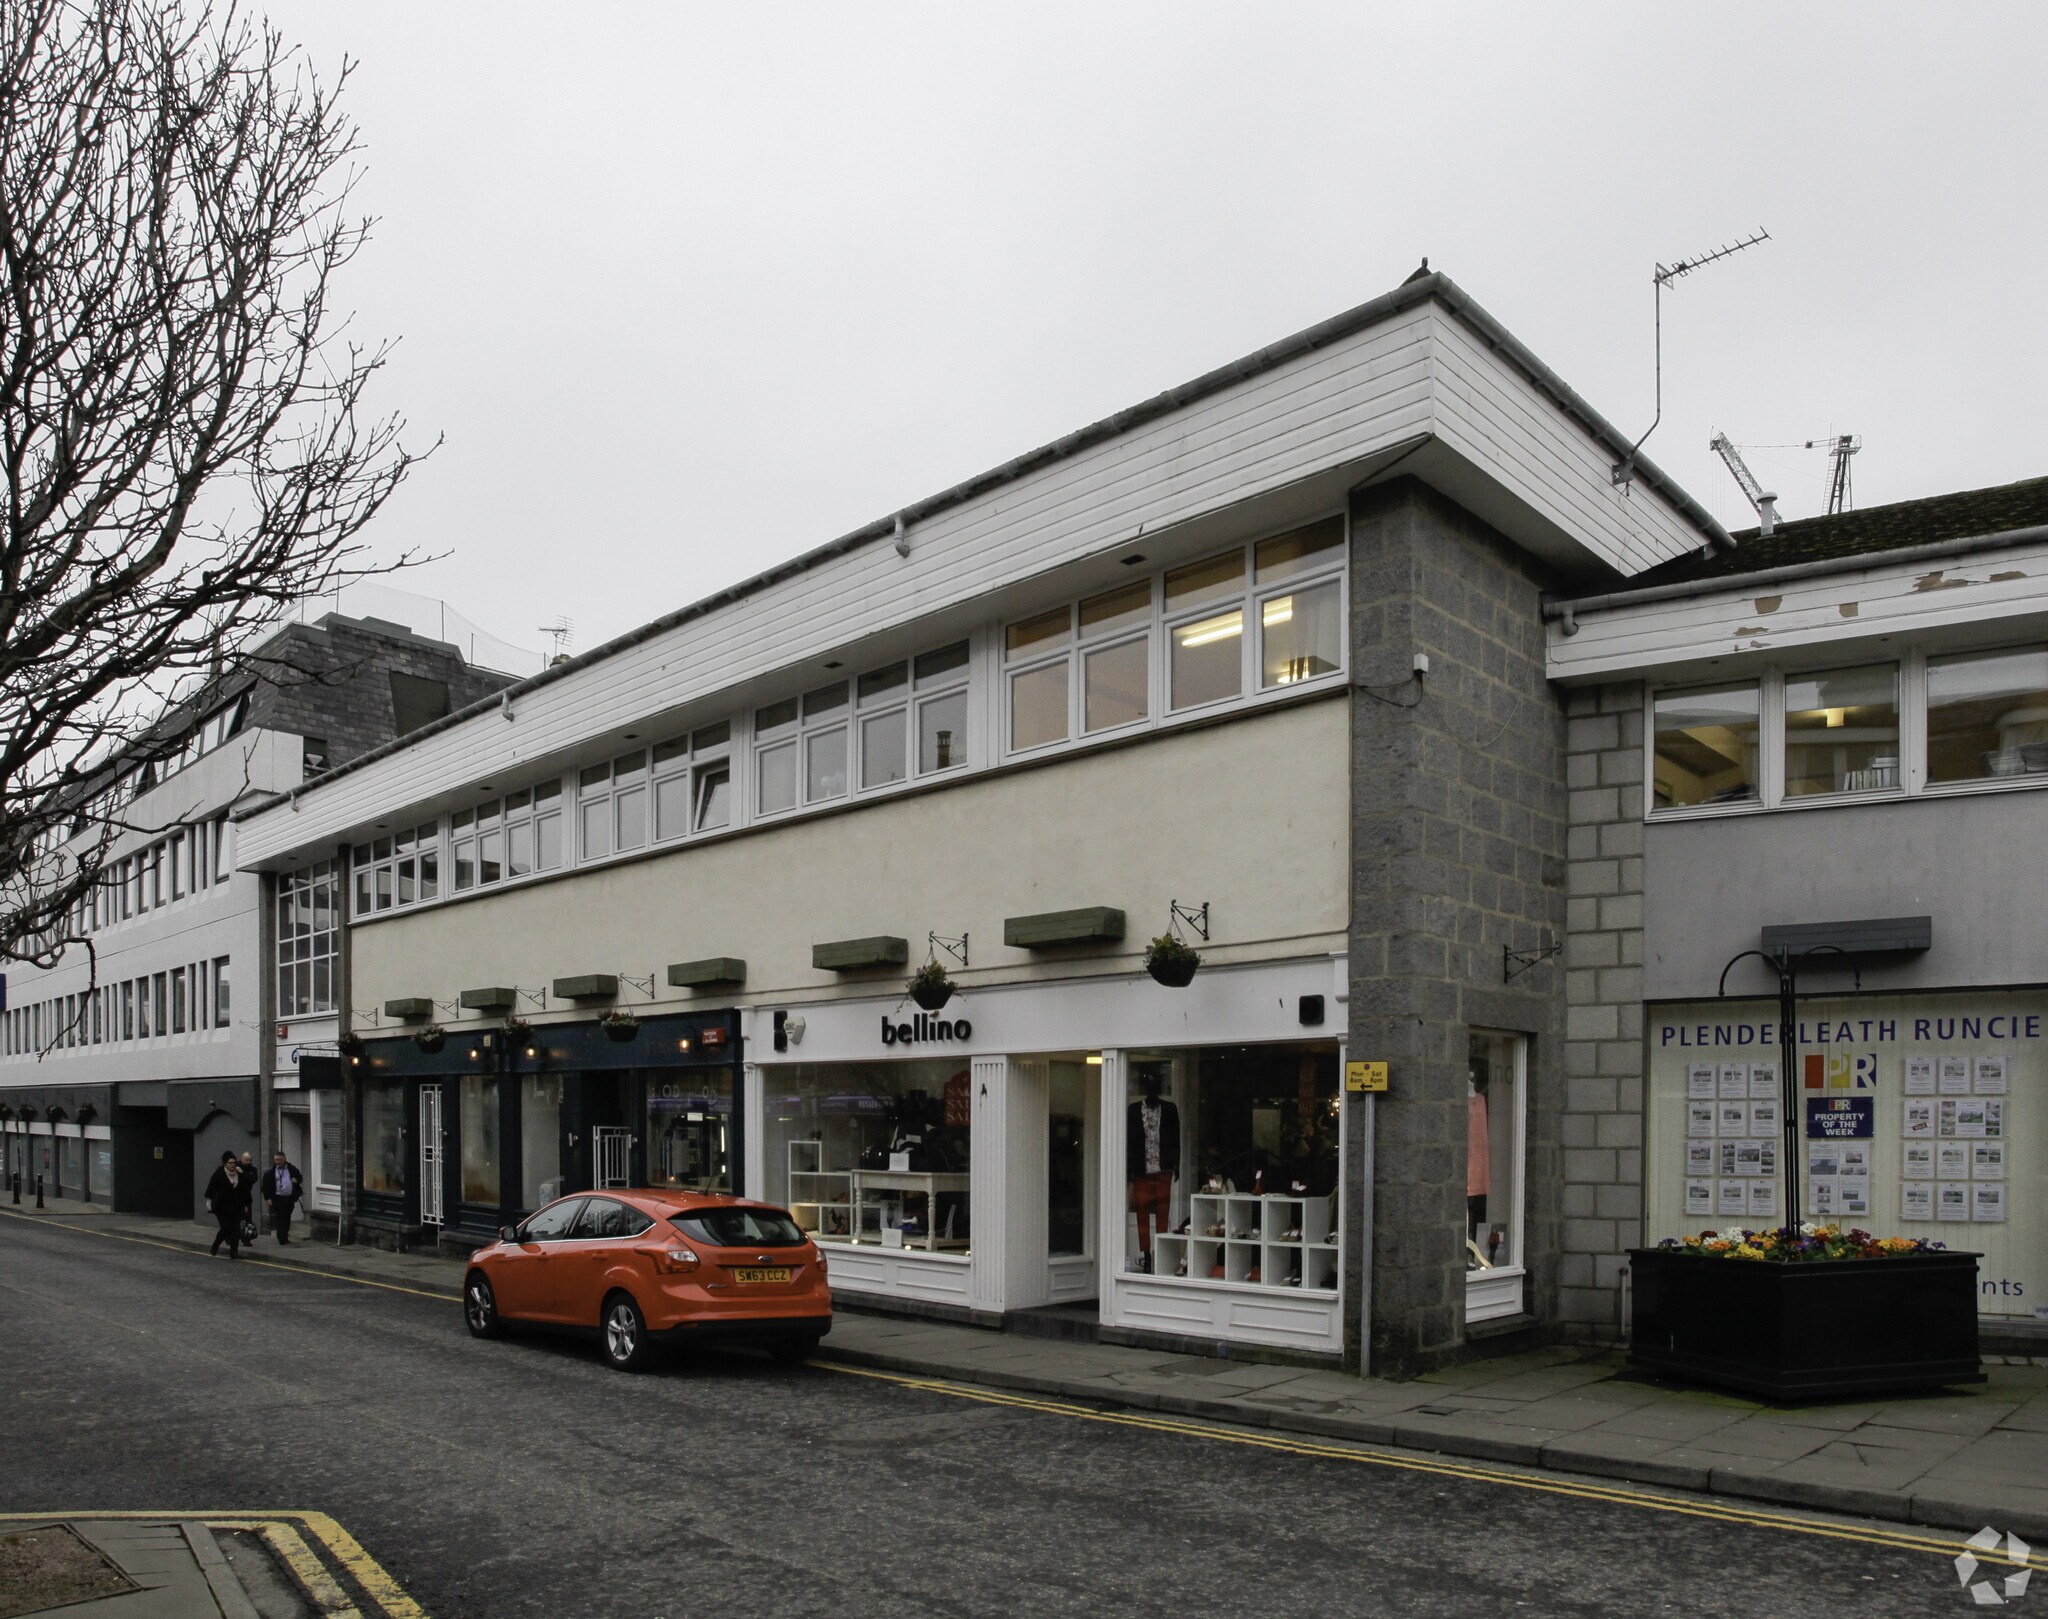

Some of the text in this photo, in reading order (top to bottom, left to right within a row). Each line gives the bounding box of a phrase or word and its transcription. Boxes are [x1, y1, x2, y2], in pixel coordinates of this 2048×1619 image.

[881, 1012, 972, 1045] bellino
[1914, 1015, 2040, 1041] RUNCIE
[1814, 1113, 1865, 1121] PROPERTY
[1839, 1120, 1857, 1128] THE
[1825, 1128, 1855, 1136] WEEK
[1982, 1278, 2024, 1297] nts
